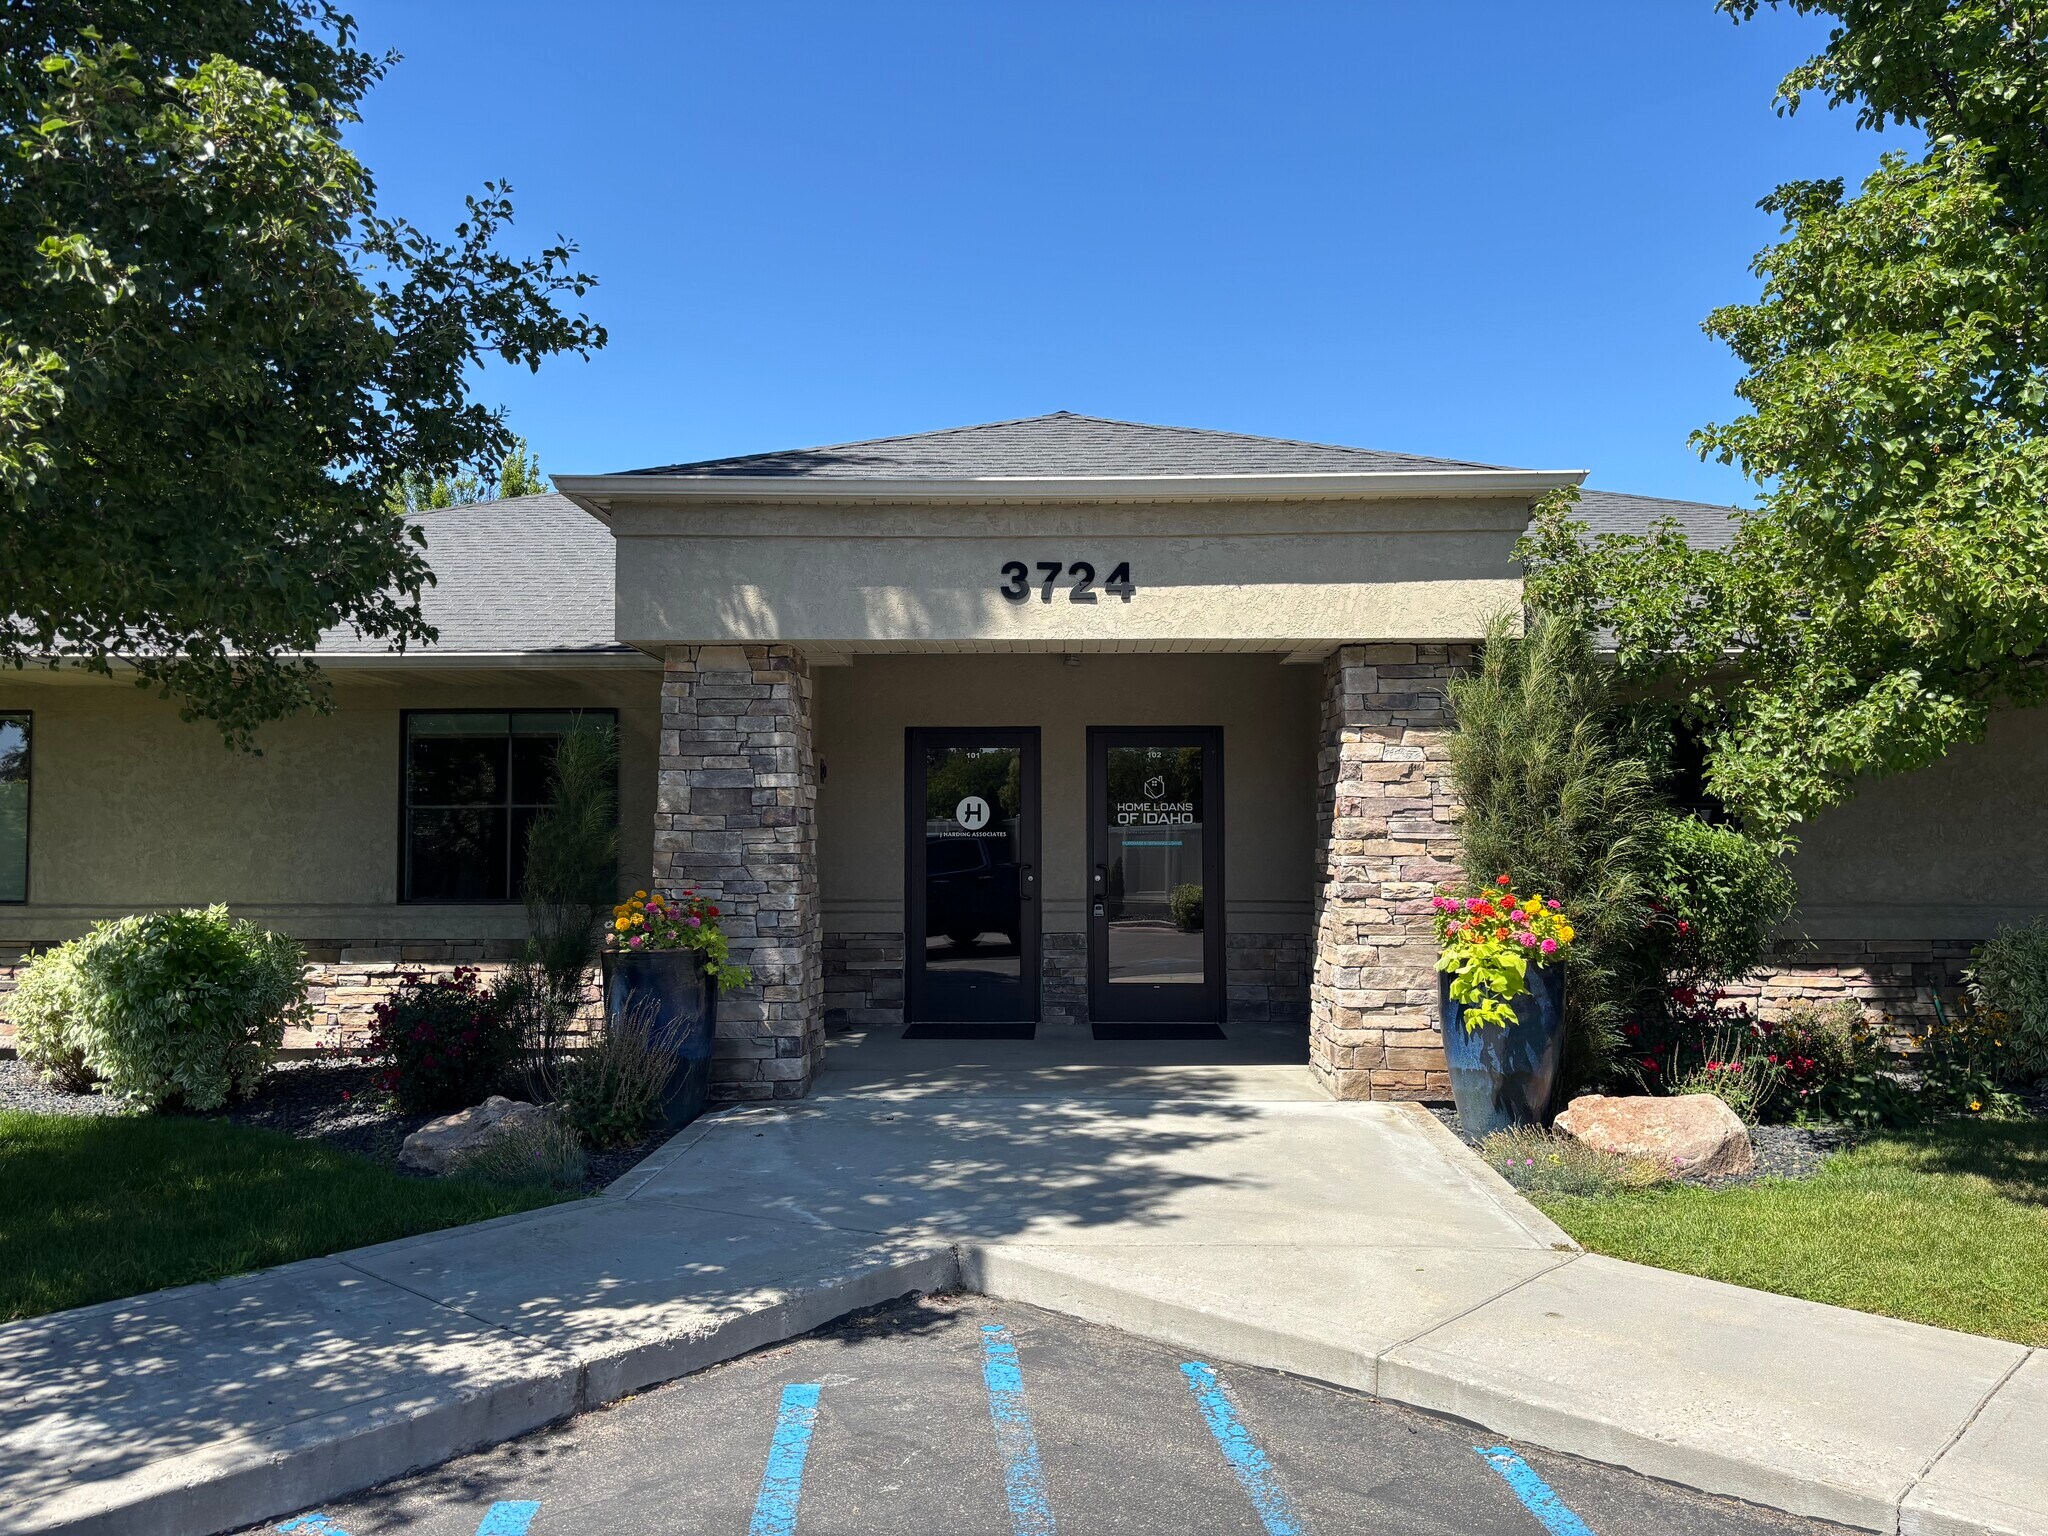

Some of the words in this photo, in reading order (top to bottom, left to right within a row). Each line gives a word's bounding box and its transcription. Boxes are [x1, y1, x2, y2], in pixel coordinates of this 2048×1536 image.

[1000, 561, 1135, 600] 3724
[1117, 803, 1151, 811] HOME
[1153, 803, 1193, 811] LOANS
[1117, 812, 1139, 824] OF
[1142, 812, 1193, 824] IDAHO
